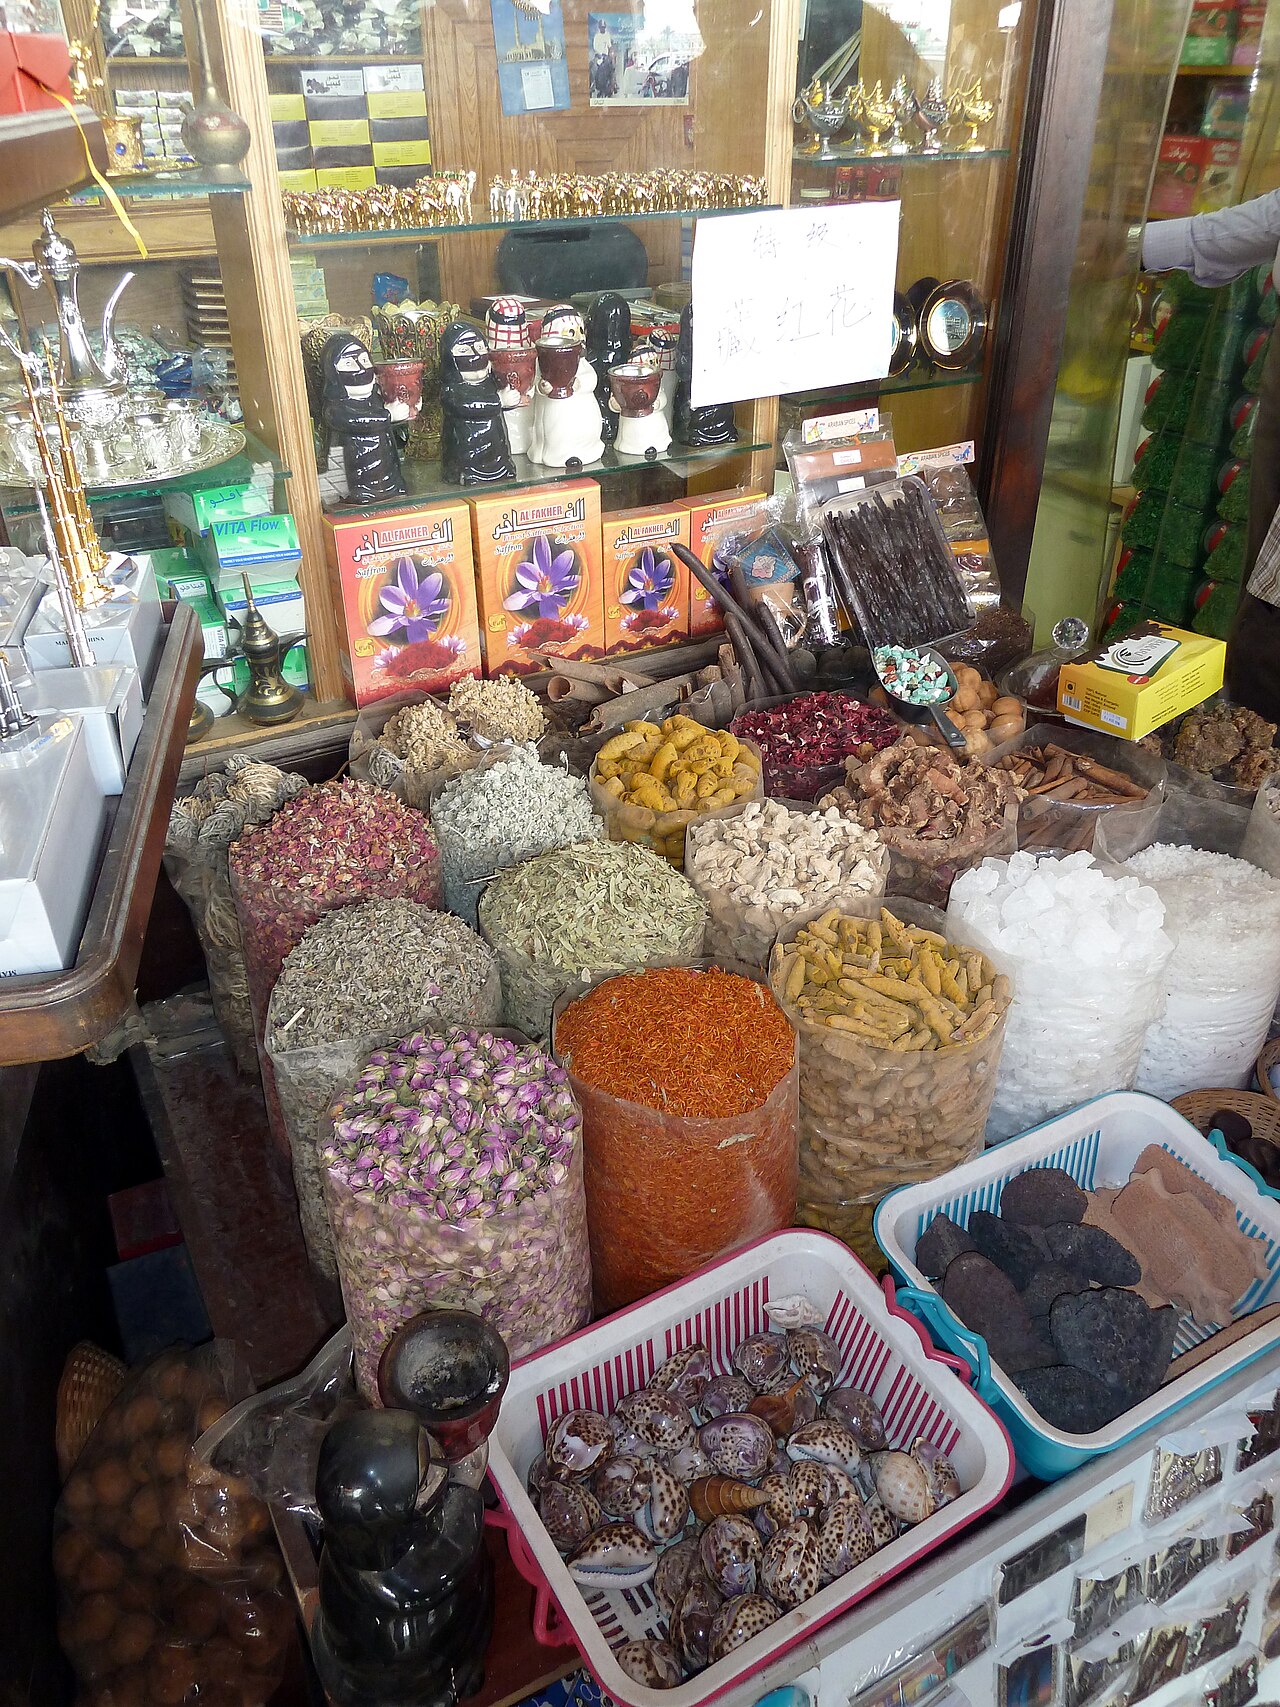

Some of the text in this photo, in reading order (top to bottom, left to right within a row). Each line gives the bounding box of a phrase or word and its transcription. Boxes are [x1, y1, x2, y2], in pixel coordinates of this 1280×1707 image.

[492, 497, 586, 540] الفاخر
[520, 505, 563, 521] AL FAKHER
[214, 520, 280, 537] VITA Flow
[382, 526, 429, 544] AL FAKHER
[613, 518, 681, 550] الفاخر
[634, 524, 664, 536] AL FAKHER
[352, 517, 454, 563] الفاخر
[495, 542, 523, 555] Saffron
[355, 565, 387, 579] Saffron
